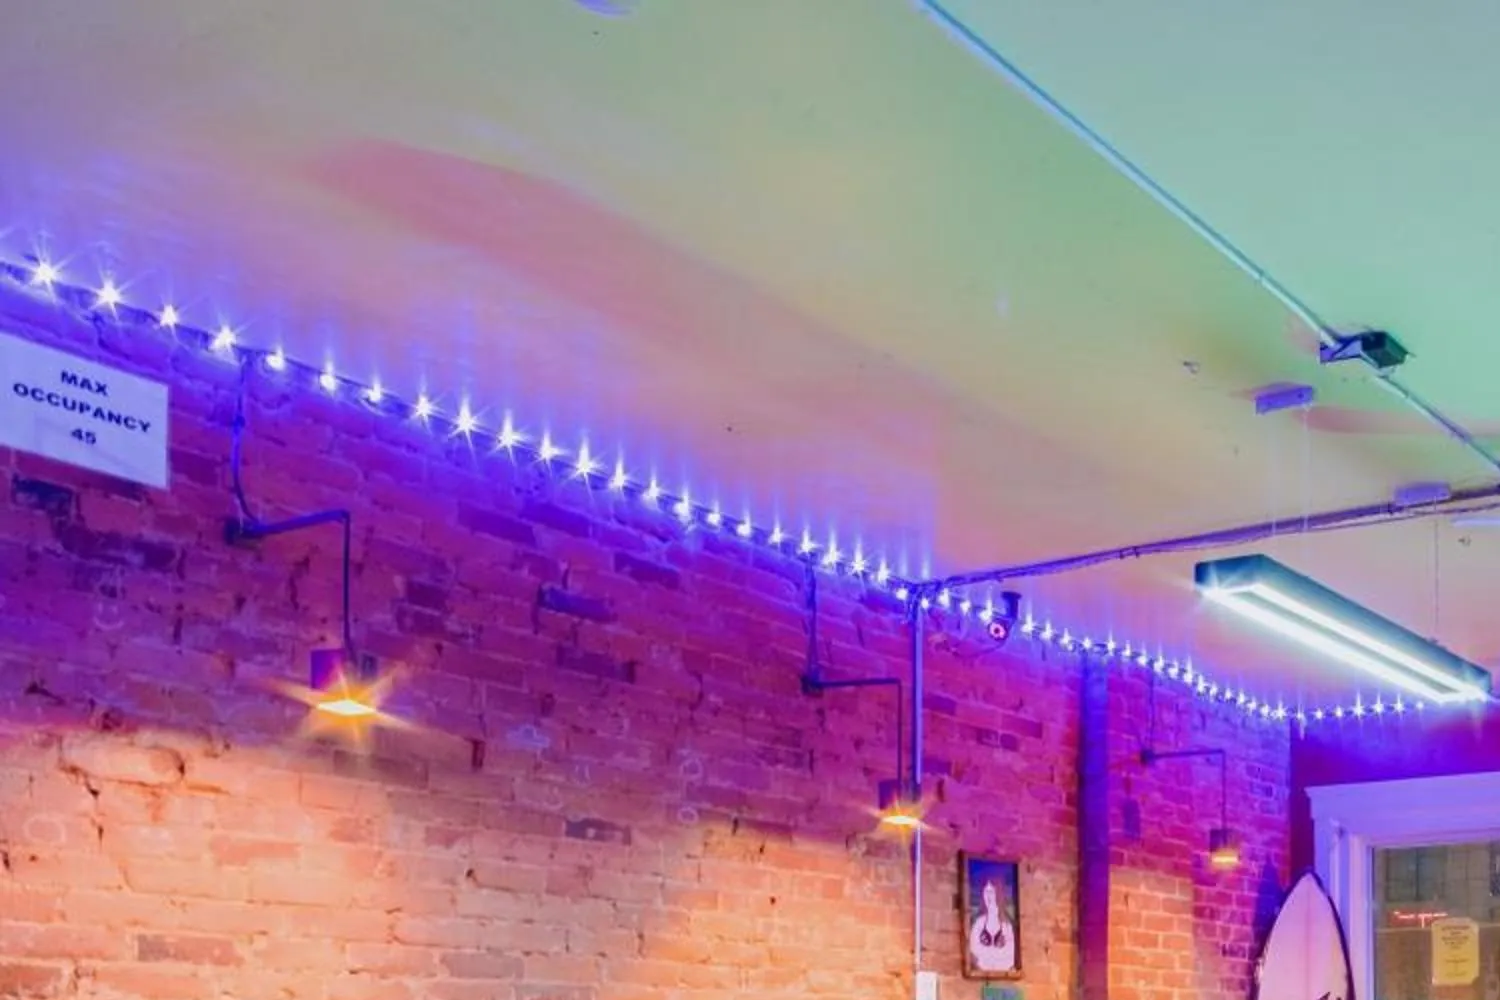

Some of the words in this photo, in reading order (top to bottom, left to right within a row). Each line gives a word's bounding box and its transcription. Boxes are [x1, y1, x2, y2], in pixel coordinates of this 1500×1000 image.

[60, 370, 108, 396] MAX
[13, 382, 151, 433] OCCUPANCY
[70, 428, 97, 445] 45
